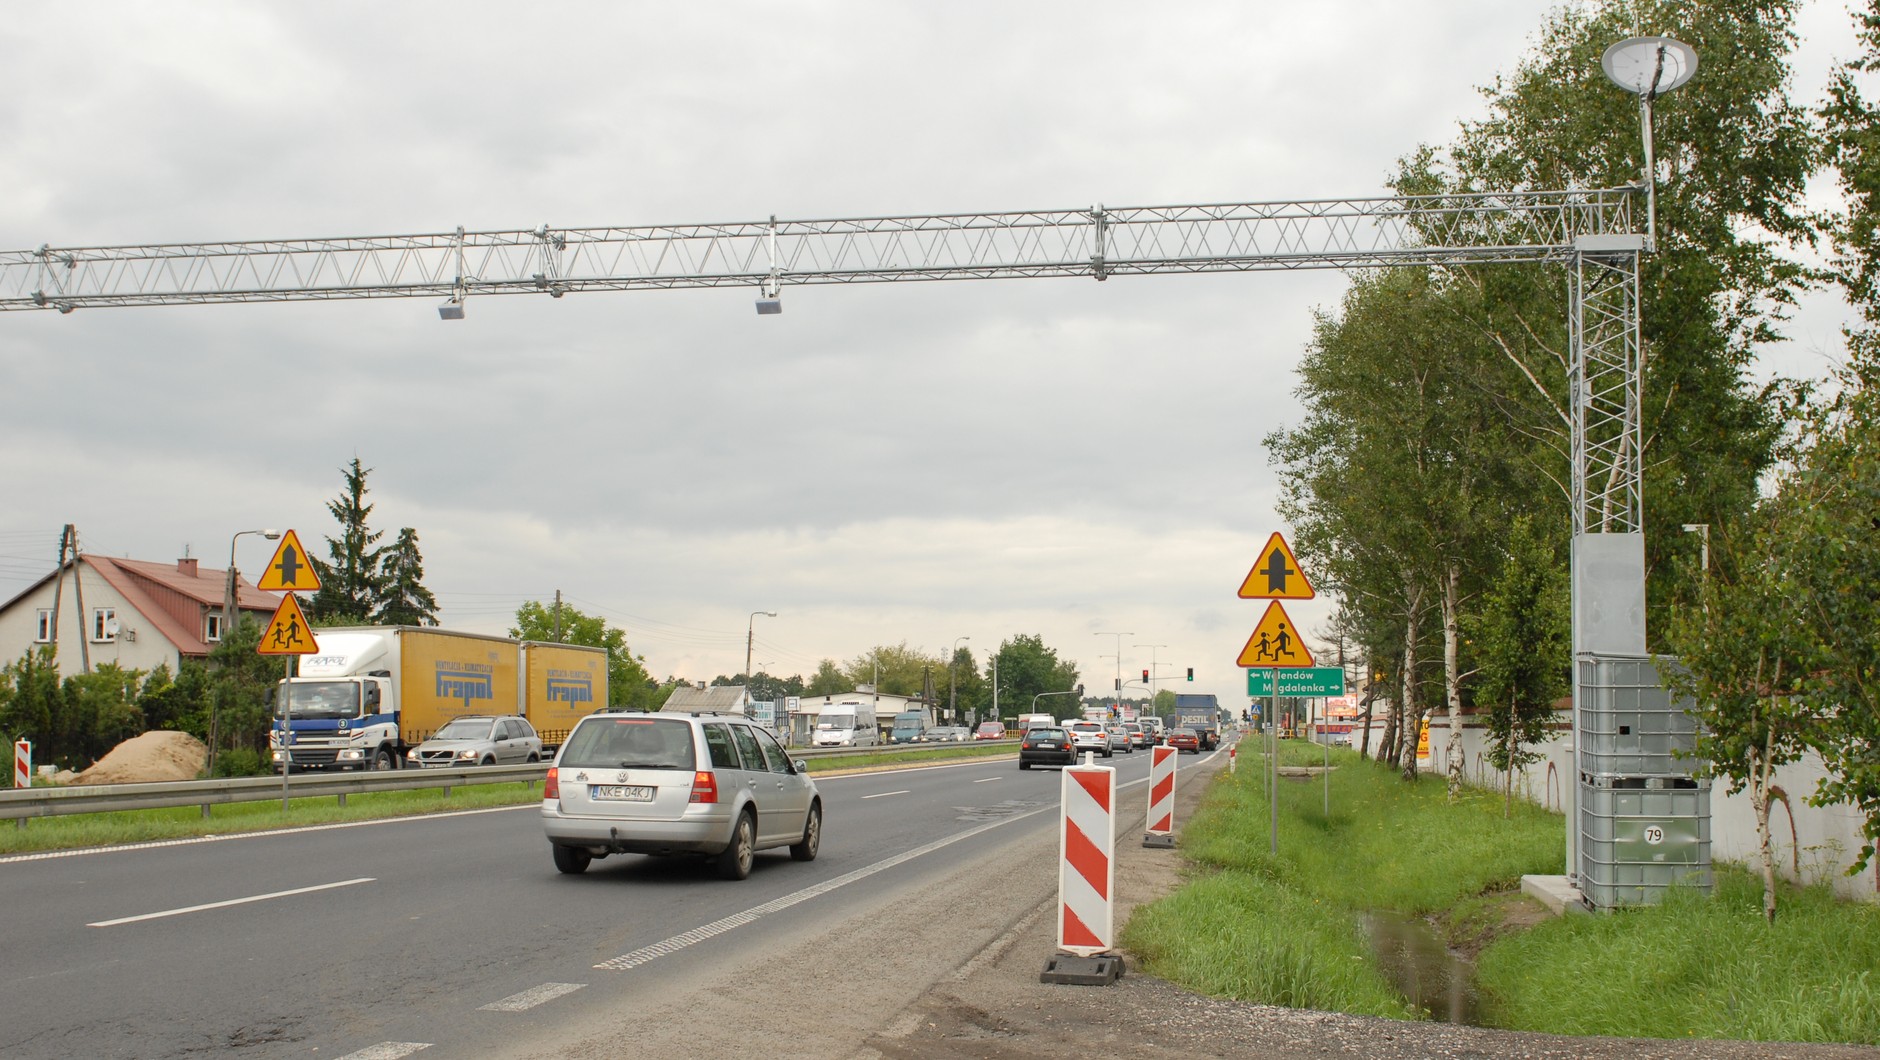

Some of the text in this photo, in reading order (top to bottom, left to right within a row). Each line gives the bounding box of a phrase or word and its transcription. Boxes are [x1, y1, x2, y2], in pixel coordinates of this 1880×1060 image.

[1181, 715, 1209, 724] DESTIL
[599, 786, 651, 798] NKE 04KJ
[1647, 829, 1662, 841] 79
